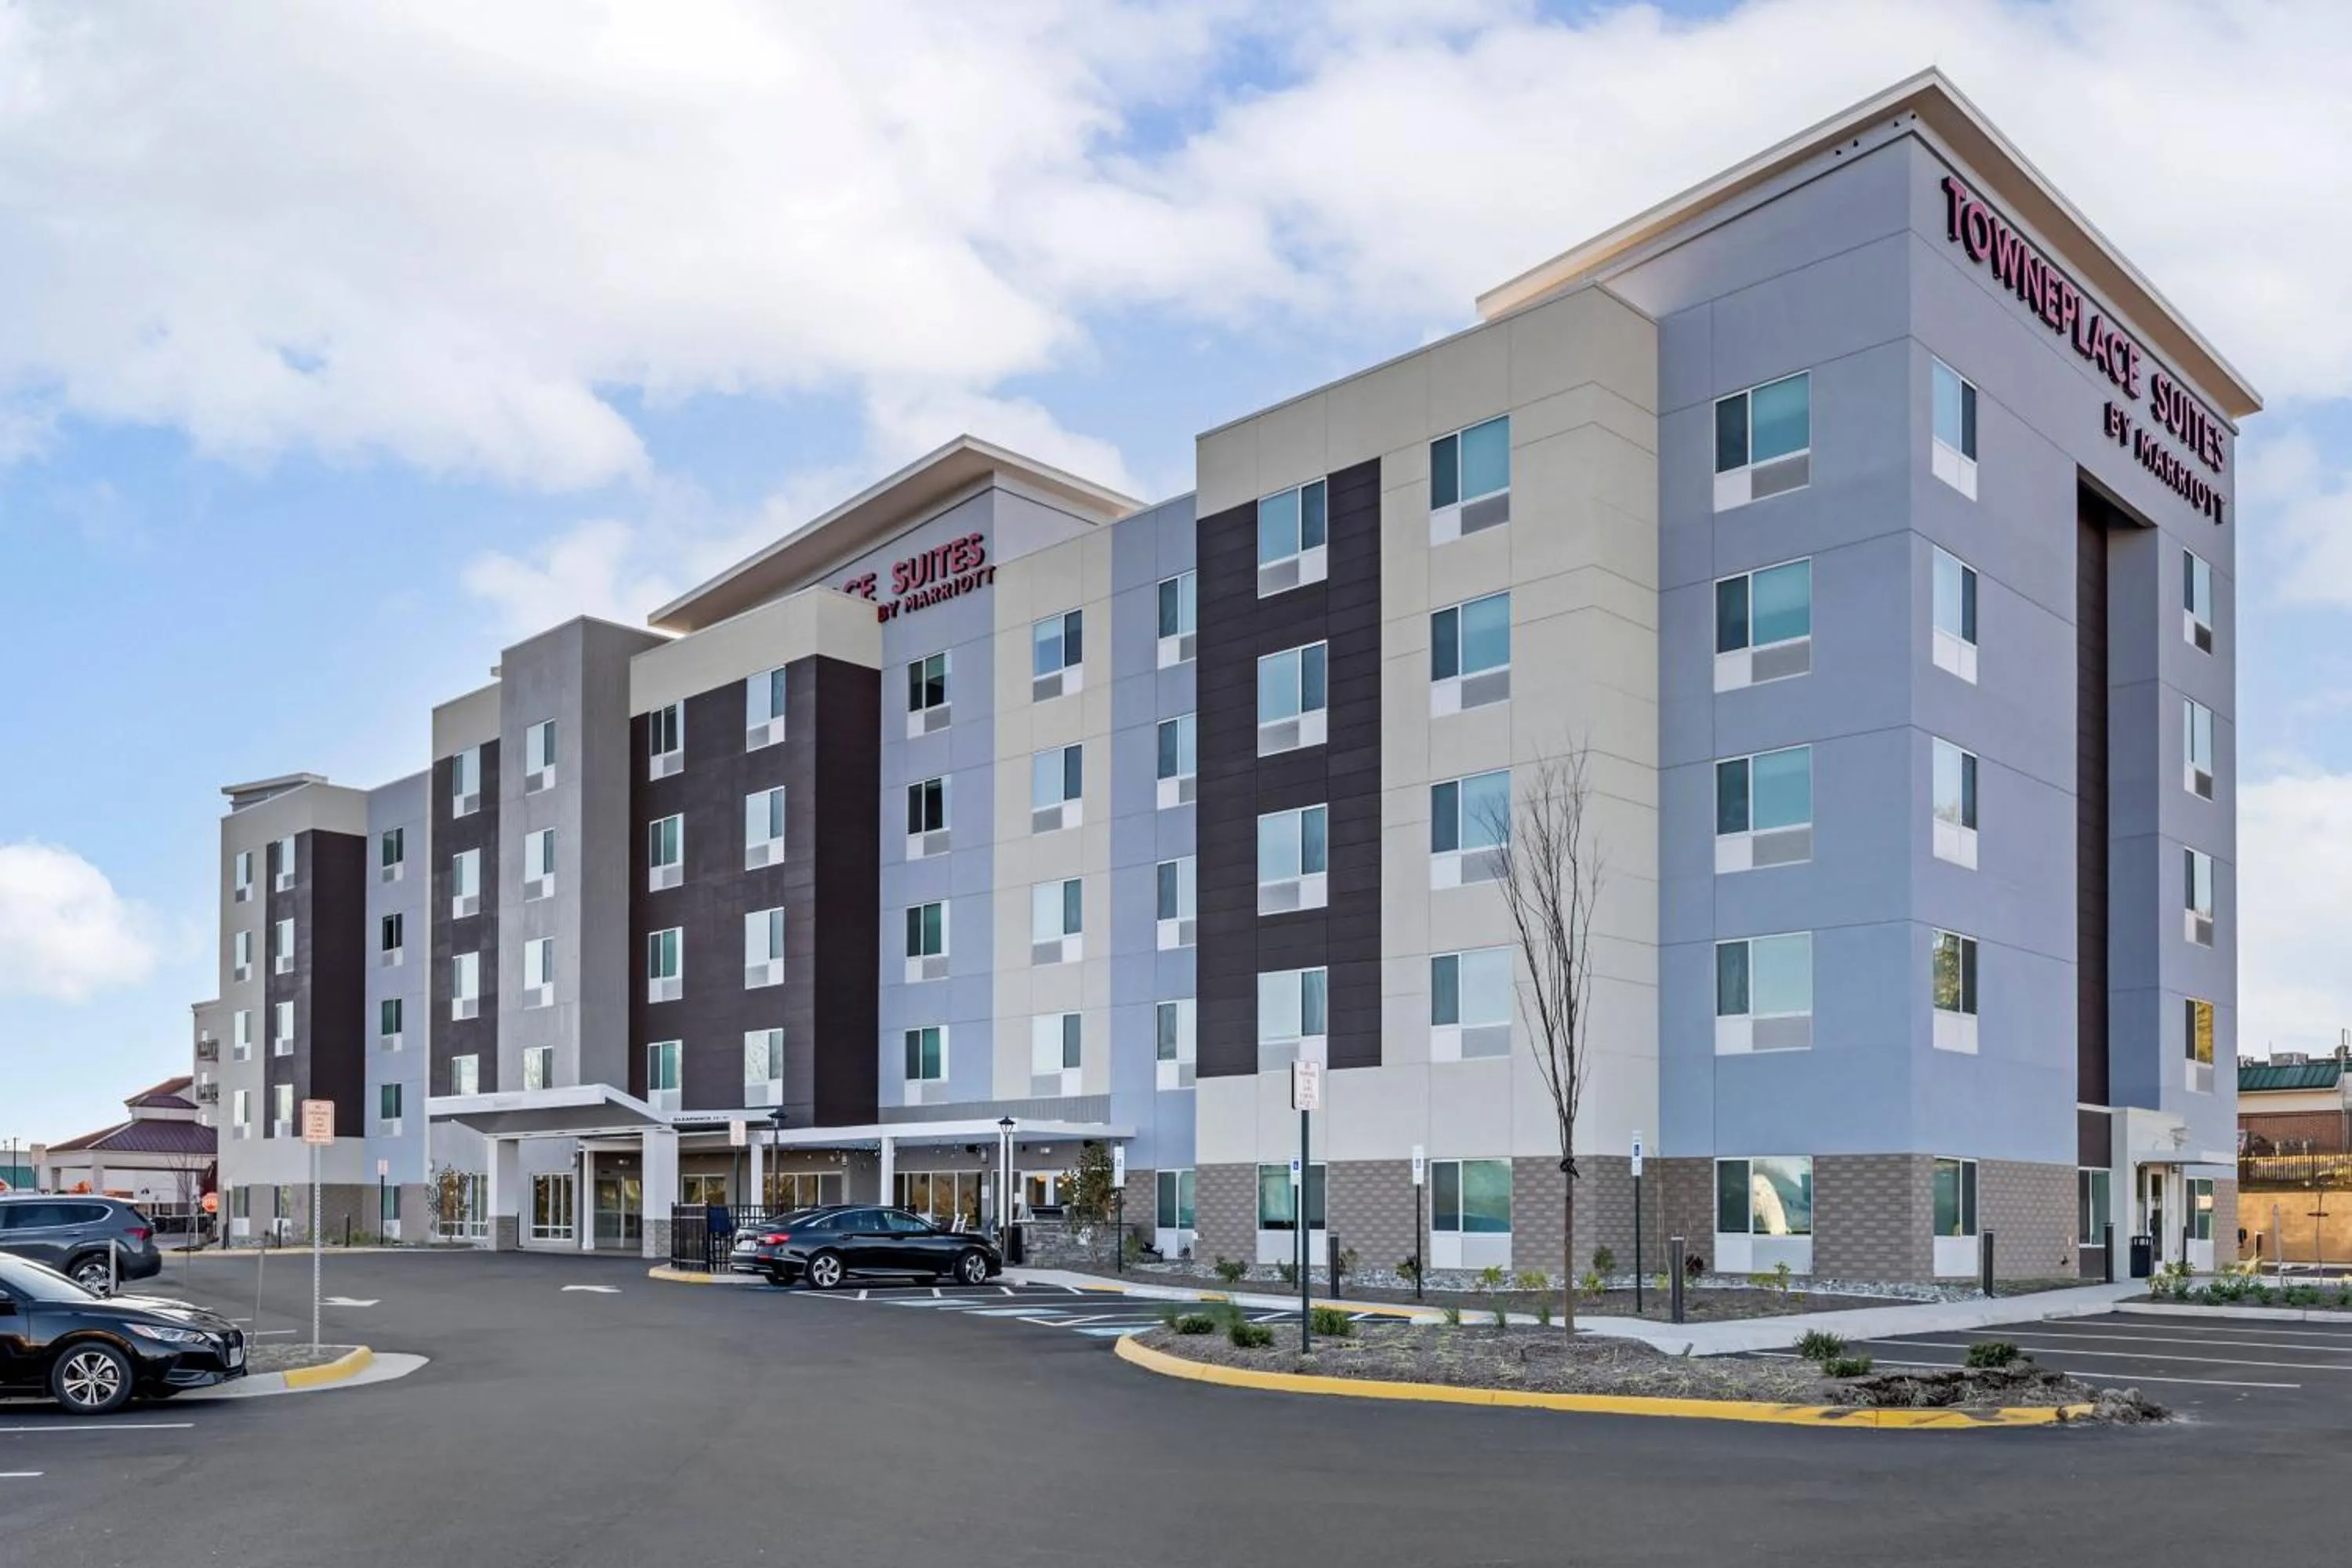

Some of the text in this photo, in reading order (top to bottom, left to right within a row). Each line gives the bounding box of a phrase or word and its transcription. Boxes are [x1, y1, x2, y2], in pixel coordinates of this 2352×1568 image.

[1941, 176, 2225, 473] TOWNEPLACE SUITES
[2103, 401, 2227, 525] BY MARRIOTT
[877, 564, 997, 624] BY MARRIOTT
[891, 532, 985, 595] SUITES
